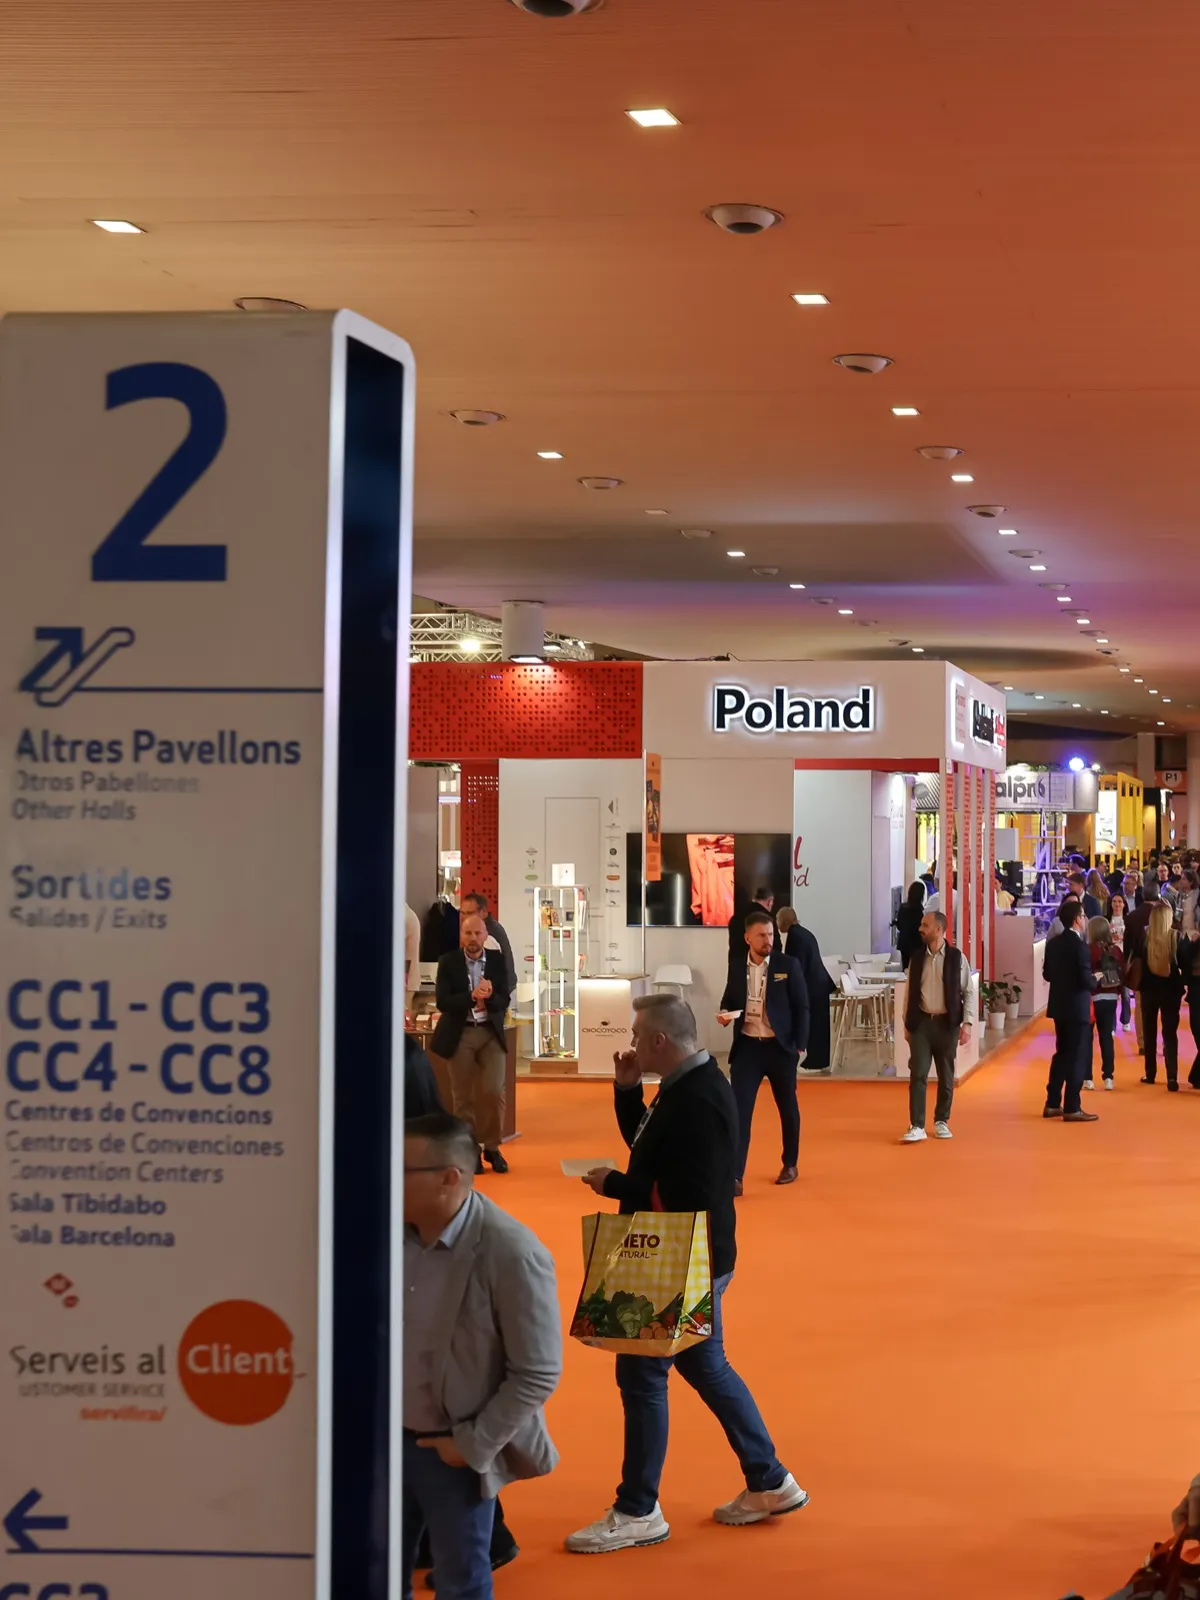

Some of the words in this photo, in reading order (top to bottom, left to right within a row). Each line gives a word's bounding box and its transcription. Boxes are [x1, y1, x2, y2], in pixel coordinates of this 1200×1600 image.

[91, 362, 229, 582] 2
[714, 686, 874, 731] Poland
[16, 728, 124, 764] Altres
[132, 730, 301, 765] Pavellons
[81, 770, 199, 793] Pabellones
[1165, 773, 1178, 782] P1
[12, 798, 74, 820] Other
[81, 800, 137, 820] Halls
[12, 864, 172, 901] Sortides
[112, 907, 167, 929] Exits
[7, 979, 118, 1032] CC1
[161, 981, 271, 1034] CC3
[6, 1040, 118, 1093] CC4
[160, 1043, 272, 1096] CC8
[5, 1100, 93, 1123] Centres
[99, 1100, 126, 1123] de
[132, 1102, 274, 1125] Convencions
[7, 1131, 93, 1153] Centros
[98, 1131, 126, 1154] de
[131, 1132, 285, 1157] Convenciones
[137, 1162, 224, 1184] Centers
[63, 1193, 167, 1215] Tibidabo
[11, 1223, 53, 1245] ala
[60, 1226, 176, 1248] Barcelona
[621, 1233, 661, 1249] IETO
[620, 1250, 650, 1259] ATURAL
[9, 1343, 126, 1376] Serveis
[137, 1343, 166, 1376] al
[187, 1343, 291, 1375] Client
[19, 1382, 97, 1397] USTOMER
